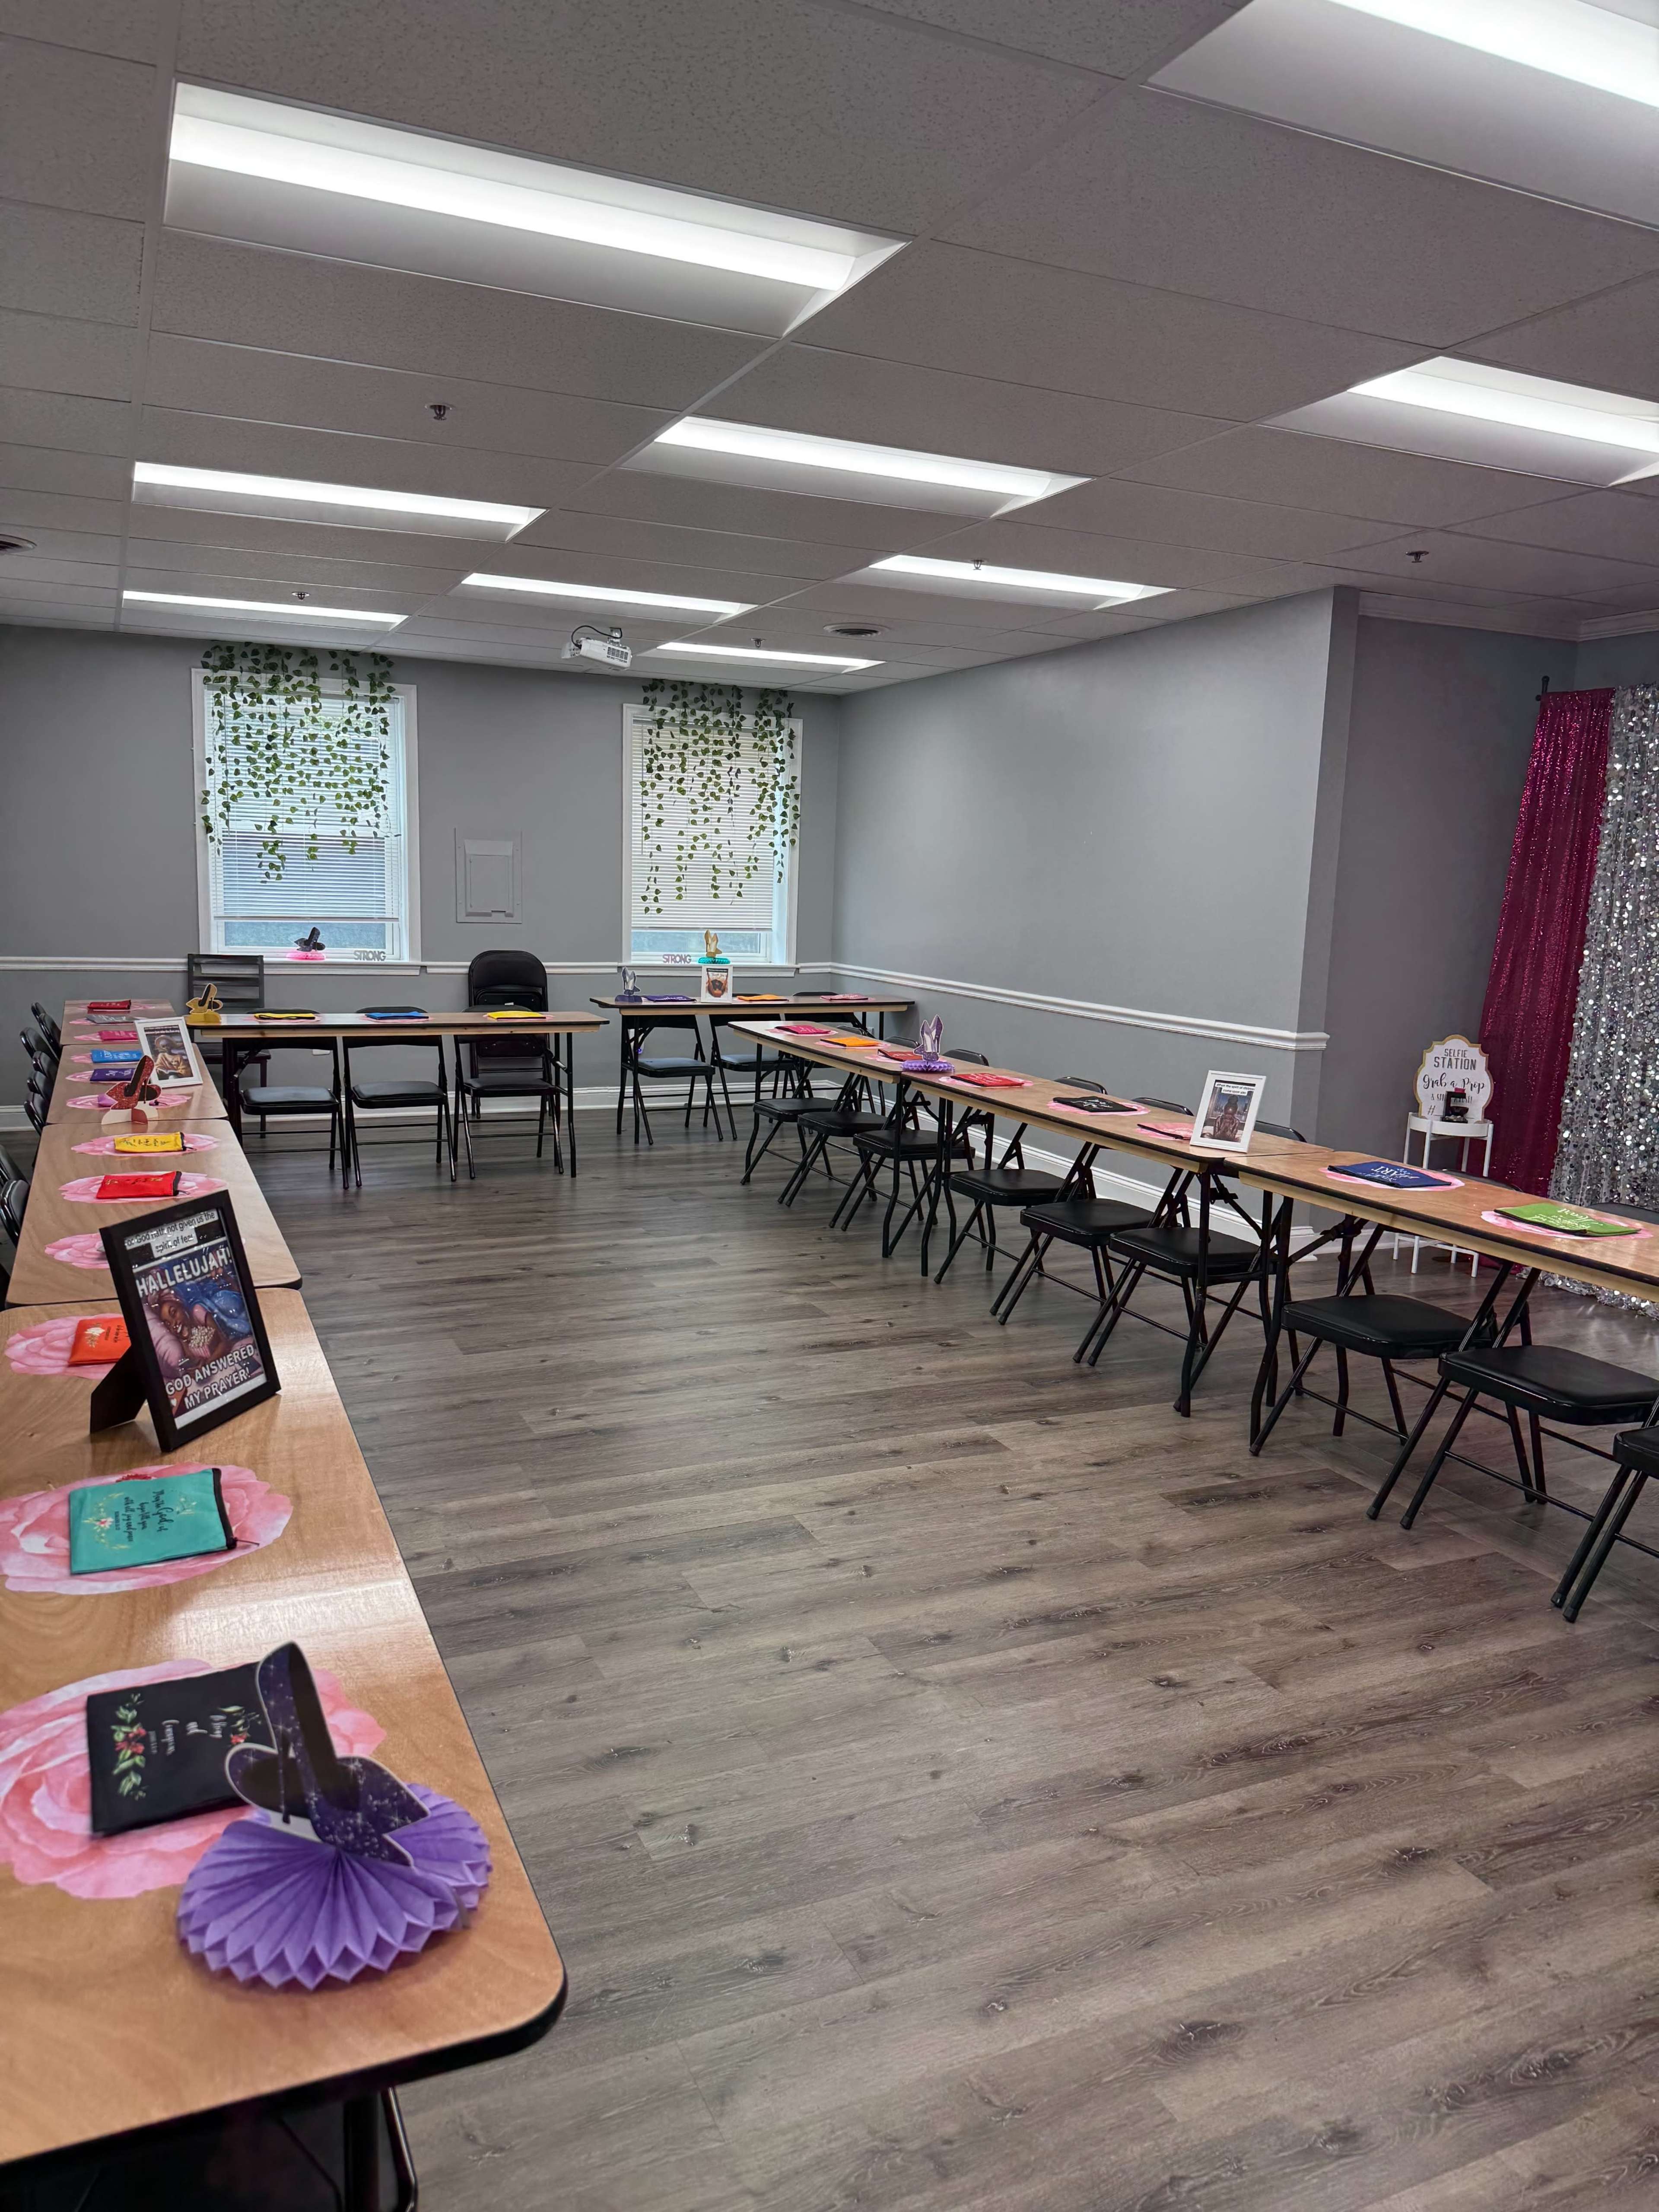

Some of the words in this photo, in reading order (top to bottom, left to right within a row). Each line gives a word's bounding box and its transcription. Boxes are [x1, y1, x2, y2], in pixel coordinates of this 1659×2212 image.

[353, 950, 386, 961] STRONG
[662, 954, 691, 964] STRONG
[1444, 1048, 1468, 1058] SELFIE
[1434, 1057, 1476, 1070] STATION
[1462, 1077, 1484, 1094] Prop
[135, 1234, 150, 1243] God
[167, 1224, 178, 1235] not
[179, 1219, 196, 1231] given
[204, 1212, 216, 1221] the
[173, 1237, 180, 1247] of
[136, 1246, 232, 1298] HALLELUJAH!
[165, 1374, 192, 1395] GOD
[194, 1344, 254, 1382] ANSWERED
[184, 1390, 201, 1410] MY
[203, 1367, 251, 1400] PRAYER!
[152, 1507, 174, 1525] God
